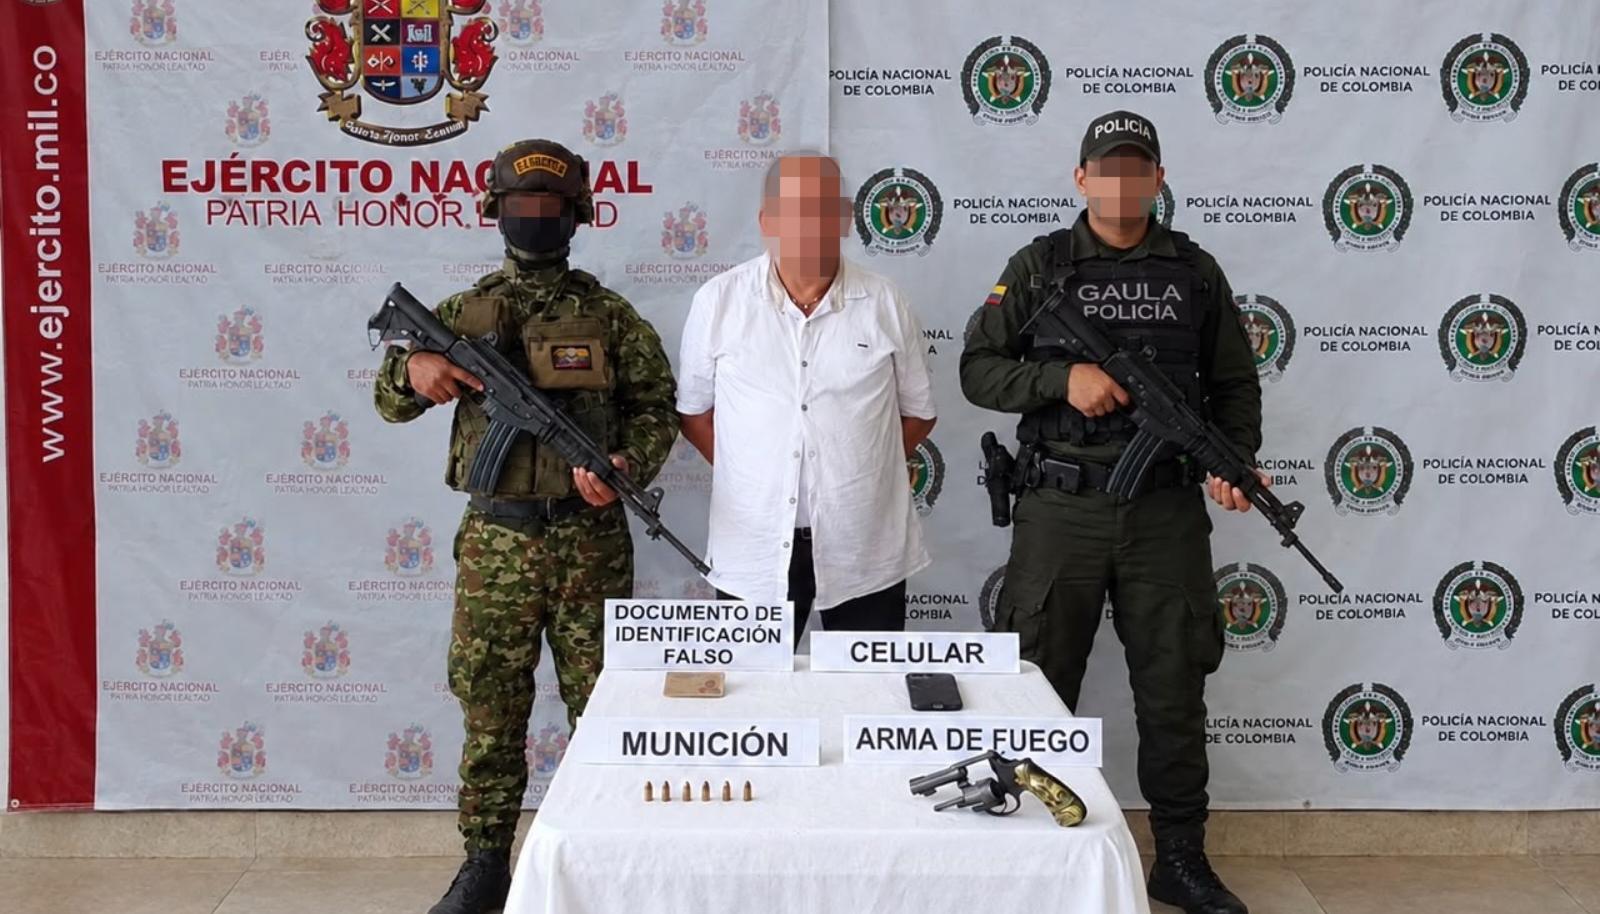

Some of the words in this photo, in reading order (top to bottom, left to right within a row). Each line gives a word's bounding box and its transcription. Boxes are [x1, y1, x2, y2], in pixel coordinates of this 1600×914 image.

[94, 49, 151, 61] EJÉRCITO
[154, 50, 214, 61] NACIONAL
[520, 50, 580, 61] NACIONAL
[624, 50, 681, 62] EJÉRCITO
[685, 51, 745, 62] NACIONAL
[829, 67, 878, 80] POLICÍA
[883, 70, 952, 80] NACIONAL
[1066, 65, 1119, 78] POLICÍA
[1123, 68, 1193, 78] NACIONAL
[1304, 64, 1356, 77] POLICÍA
[1361, 66, 1430, 76] NACIONAL
[1542, 62, 1593, 75] POLICÍA
[844, 85, 860, 96] DE
[866, 85, 934, 96] COLOMBIA
[1083, 83, 1100, 94] DE
[1104, 83, 1176, 94] COLOMBIA
[1320, 82, 1338, 92] DE
[1342, 82, 1412, 92] COLOMBIA
[1559, 80, 1576, 90] DE
[1094, 120, 1151, 140] POLICÍA
[704, 149, 758, 160] EJÉRCITO
[162, 152, 393, 193] EJÉRCITO
[411, 160, 652, 193] NACAL
[954, 196, 1004, 209] POLICÍA
[1008, 198, 1076, 208] NACIONAL
[1186, 196, 1238, 208] POLICÍA
[1243, 198, 1313, 207] NACIONAL
[1424, 193, 1476, 207] POLICÍA
[1481, 195, 1551, 206] NACIONAL
[206, 200, 321, 226] PATRIA
[970, 213, 986, 224] DE
[991, 213, 1060, 224] COLOMBIA
[1204, 213, 1220, 223] DE
[1226, 213, 1296, 223] COLOMBIA
[1440, 210, 1458, 222] DE
[1462, 210, 1534, 222] COLOMBIA
[28, 45, 69, 462] www.ejercito.mil.co
[98, 262, 154, 274] EJÉRCITO
[157, 263, 216, 274] NACIONAL
[264, 262, 322, 274] EJÉRCITO
[625, 262, 682, 274] EJÉRCITO
[1078, 283, 1182, 301] GAULA
[1084, 302, 1178, 320] POLICÍA
[1304, 324, 1355, 337] POLICÍA
[1359, 326, 1428, 336] NACIONAL
[1538, 322, 1590, 335] POLICÍA
[1320, 341, 1337, 351] DE
[1342, 341, 1410, 351] COLOMBIA
[1555, 340, 1572, 350] DE
[179, 368, 236, 380] EJÉRCITO
[240, 369, 300, 380] NACIONAL
[1256, 460, 1315, 470] ACIONAL
[1424, 456, 1472, 469] POLICÍA
[1477, 459, 1545, 468] NACIONAL
[100, 472, 155, 484] EJÉRCITO
[159, 473, 218, 484] NACIONAL
[266, 473, 323, 484] EJÉRCITO
[326, 474, 388, 484] NACIONAL
[1438, 474, 1454, 484] DE
[1459, 474, 1528, 484] COLOMBIA
[180, 580, 237, 591] EJÉRCITO
[241, 580, 302, 591] NACIONAL
[348, 580, 406, 591] EJÉRCITO
[1534, 590, 1588, 603] POLICÍA
[615, 605, 748, 621] DOCUMENTO
[756, 606, 782, 621] DE
[1316, 609, 1332, 620] DE
[1338, 609, 1406, 620] COLOMBIA
[1552, 609, 1569, 618] DE
[615, 624, 782, 643] IDENTIFICACIÓN
[664, 649, 733, 664] FALSO
[850, 642, 984, 664] CELULAR
[102, 680, 157, 692] EJÉRCITO
[160, 682, 218, 692] NACIONAL
[266, 682, 323, 693] EJÉRCITO
[326, 684, 387, 693] NACIONAL
[1206, 716, 1240, 728] LICÍA
[1243, 718, 1313, 728] NACIONAL
[1422, 713, 1473, 726] POLICÍA
[1478, 716, 1546, 726] NACIONAL
[622, 726, 788, 756] MUNICIÓN
[856, 728, 938, 751] ARMA
[947, 728, 983, 751] DE
[993, 729, 1090, 753] FUEGO
[1205, 733, 1221, 743] DE
[1225, 733, 1296, 743] COLOMBIA
[1439, 731, 1455, 742] DE
[1460, 731, 1529, 742] COLOMBIA
[181, 782, 238, 794] EJÉRCITO
[242, 783, 302, 794] NACIONAL
[350, 782, 406, 793] EJÉRCITO
